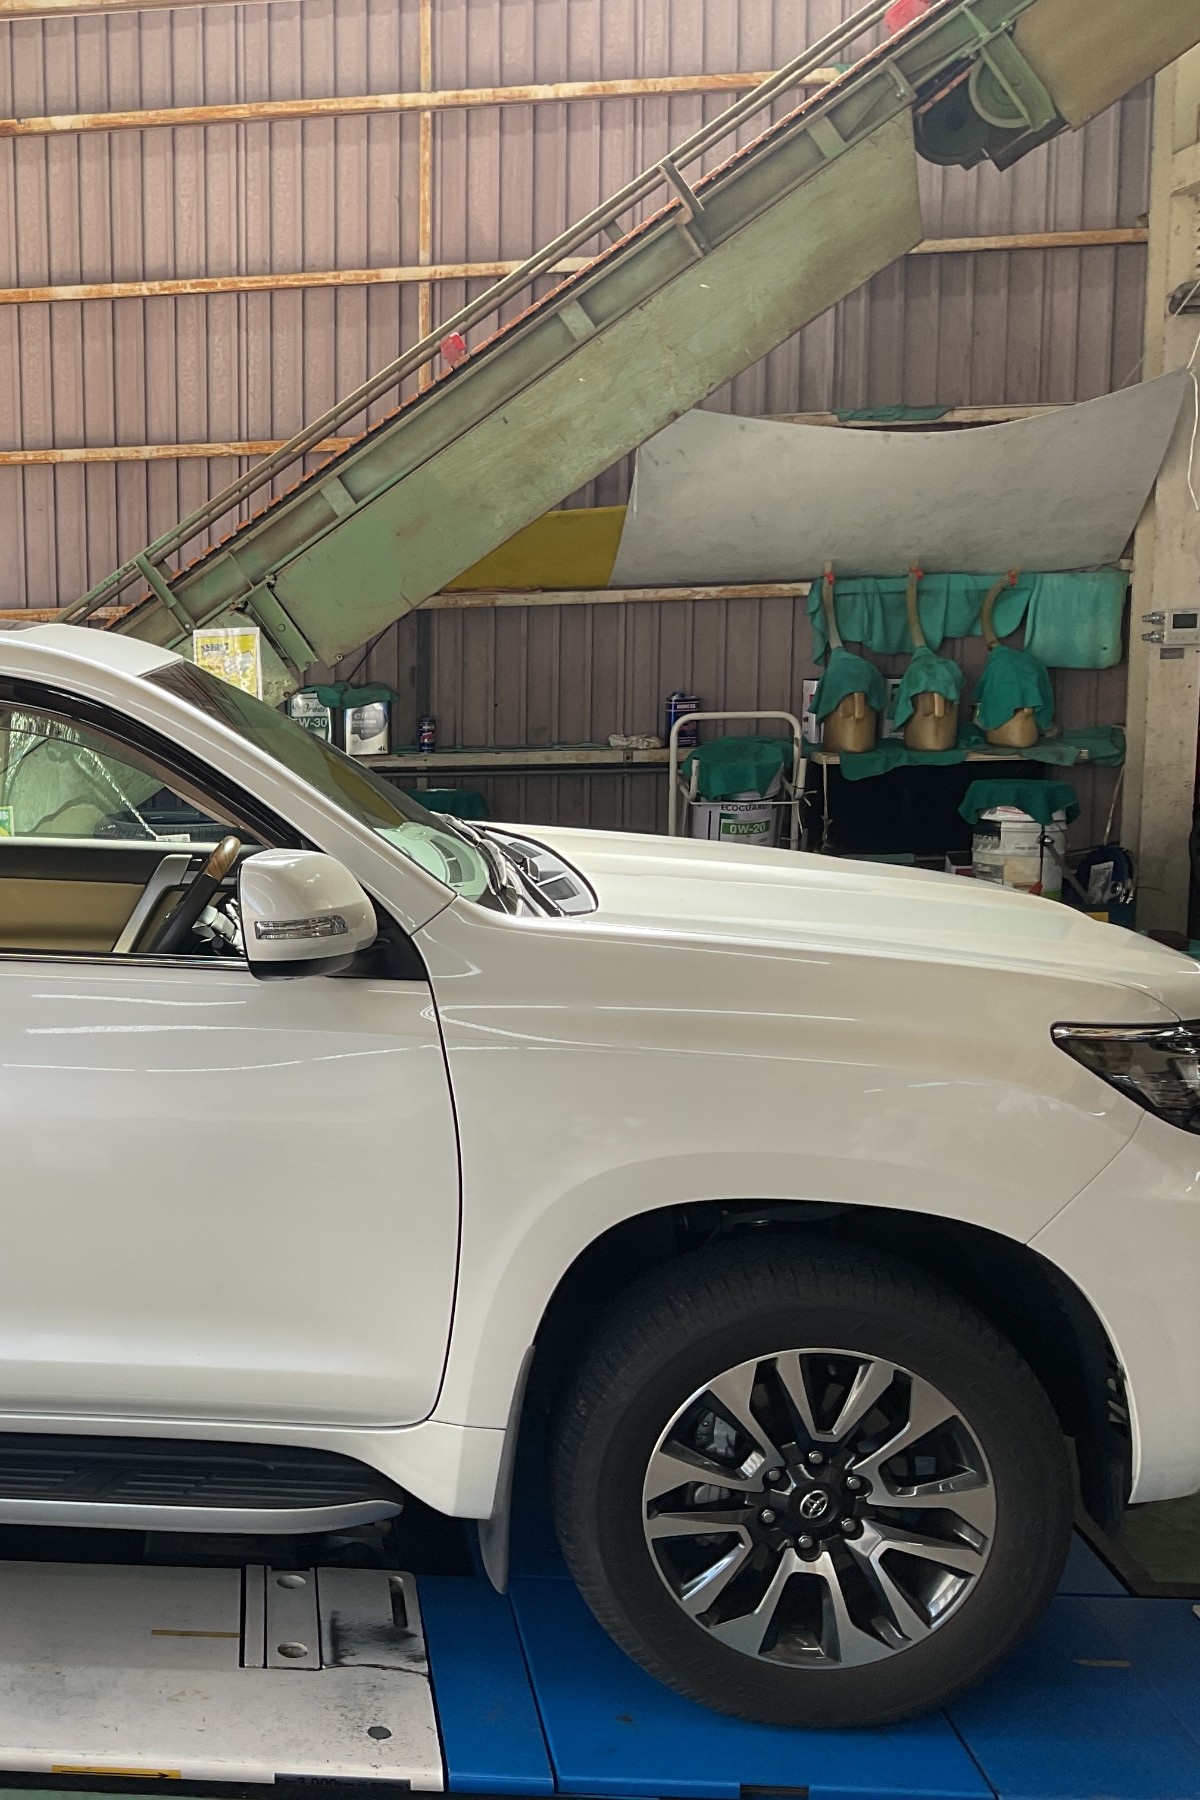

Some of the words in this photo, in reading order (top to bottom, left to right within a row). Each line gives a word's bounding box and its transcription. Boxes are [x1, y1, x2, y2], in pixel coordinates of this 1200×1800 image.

[292, 717, 328, 728] W-30
[720, 804, 768, 812] ECOGUARD
[729, 823, 766, 834] 0W-20
